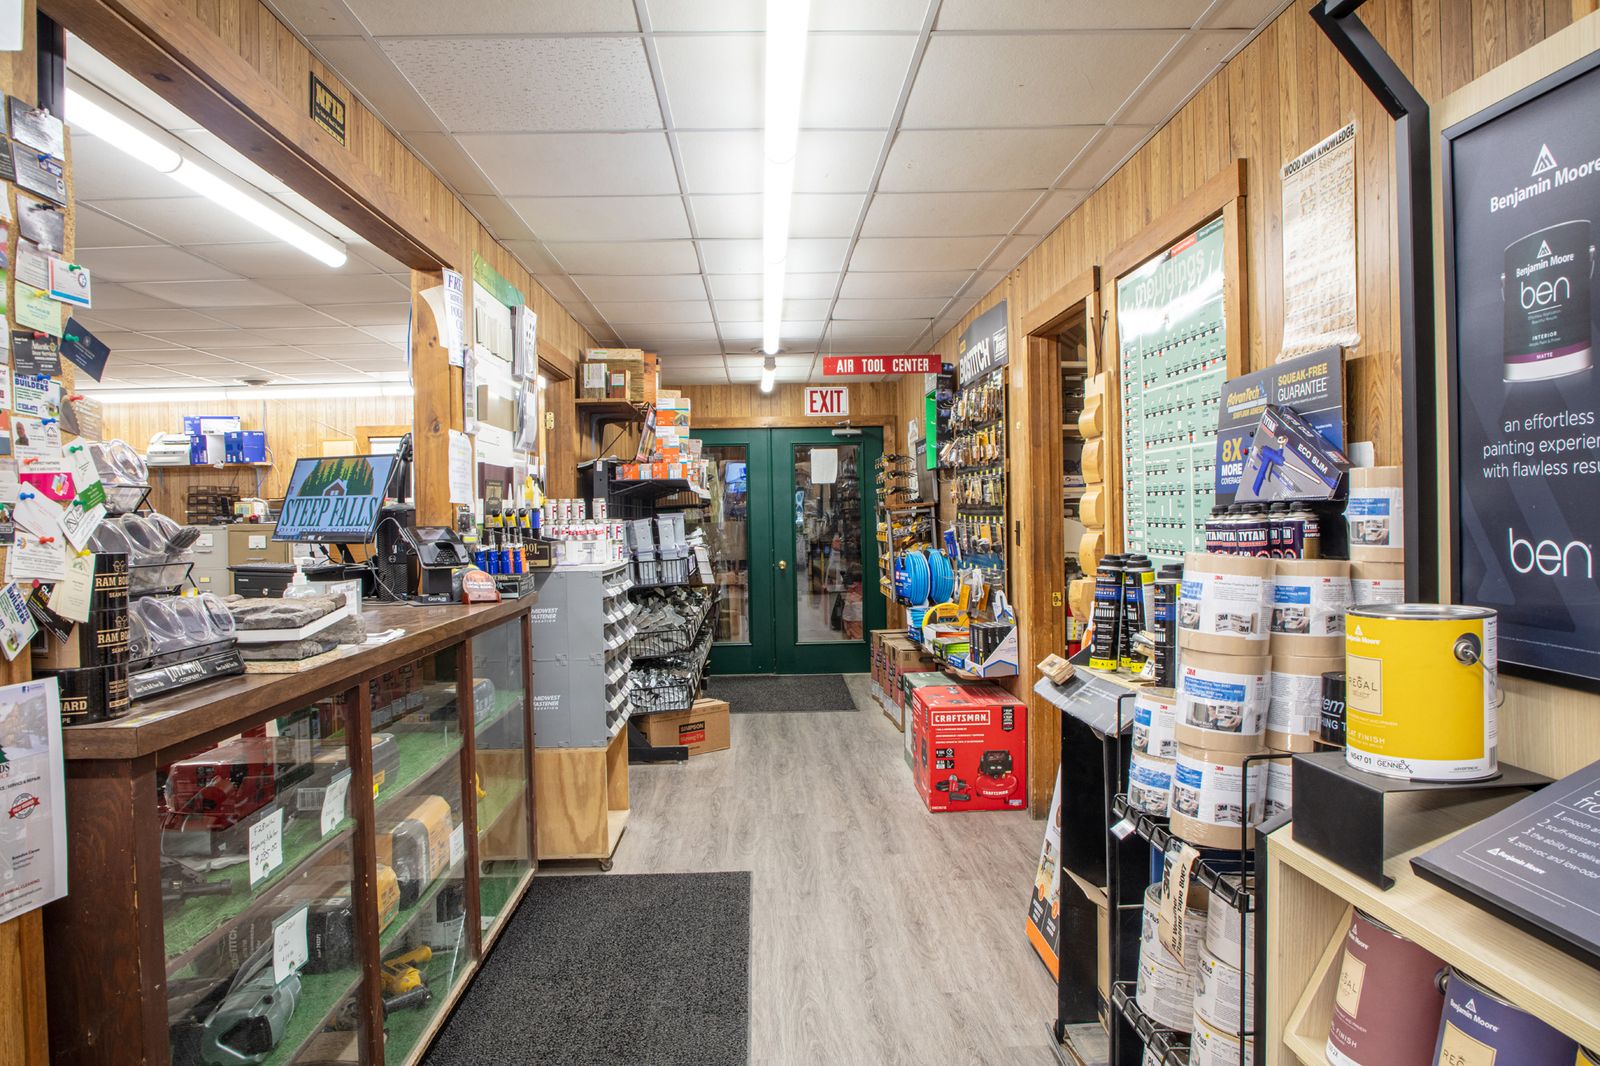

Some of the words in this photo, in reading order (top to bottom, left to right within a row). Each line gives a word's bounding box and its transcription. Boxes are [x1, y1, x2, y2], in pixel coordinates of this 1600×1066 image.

[1284, 159, 1300, 177] WOOD
[1317, 123, 1354, 157] KNOWLEDGE
[1490, 177, 1551, 214] Benjamin
[1516, 258, 1549, 278] Benjamin
[1550, 253, 1574, 267] Moore
[1521, 276, 1570, 310] ben
[1532, 331, 1557, 341] INTERIOR
[836, 359, 854, 373] AIR
[862, 358, 885, 373] TOOL
[892, 358, 929, 372] CENTER
[960, 337, 990, 385] BOSTITCH
[1536, 352, 1553, 360] MATTE
[1278, 363, 1328, 387] SQUEAK-FREE
[15, 378, 49, 392] BUILDERS
[1277, 378, 1328, 402] GUARANTEE
[809, 390, 844, 413] EXIT
[1504, 419, 1520, 433] an
[1524, 410, 1595, 431] effortless
[1221, 437, 1243, 463] 8X
[1483, 438, 1535, 460] painting
[1297, 443, 1312, 459] ECO
[1311, 456, 1329, 475] SLIM
[1221, 462, 1243, 476] MORE
[1483, 463, 1509, 479] with
[1512, 460, 1568, 477] flawless
[281, 498, 330, 528] STEEP
[327, 496, 378, 528] FALLS
[1238, 530, 1265, 541] TYTAN
[1508, 527, 1593, 579] ben
[95, 576, 116, 587] RAM
[6, 587, 27, 625] BUILDERS
[1217, 613, 1228, 621] 3M
[98, 632, 119, 644] RAM
[1239, 625, 1249, 633] 3M
[1186, 667, 1196, 676] 3M
[533, 694, 561, 702] MIDWEST
[935, 714, 987, 723] CRAFTSMAN
[1358, 732, 1385, 745] FINISH
[1364, 755, 1372, 765] 01
[1376, 759, 1413, 774] GENNEX
[1217, 804, 1228, 812] 3M
[1561, 816, 1591, 830] smooth
[1530, 832, 1545, 841] the
[1543, 838, 1568, 851] ability
[1567, 847, 1578, 855] to
[1546, 854, 1566, 864] and
[1163, 857, 1173, 900] 3M
[1178, 863, 1187, 889] 8067
[1201, 959, 1213, 975] Plus
[1473, 1014, 1499, 1033] Moore
[1335, 1027, 1357, 1049] FINISH
